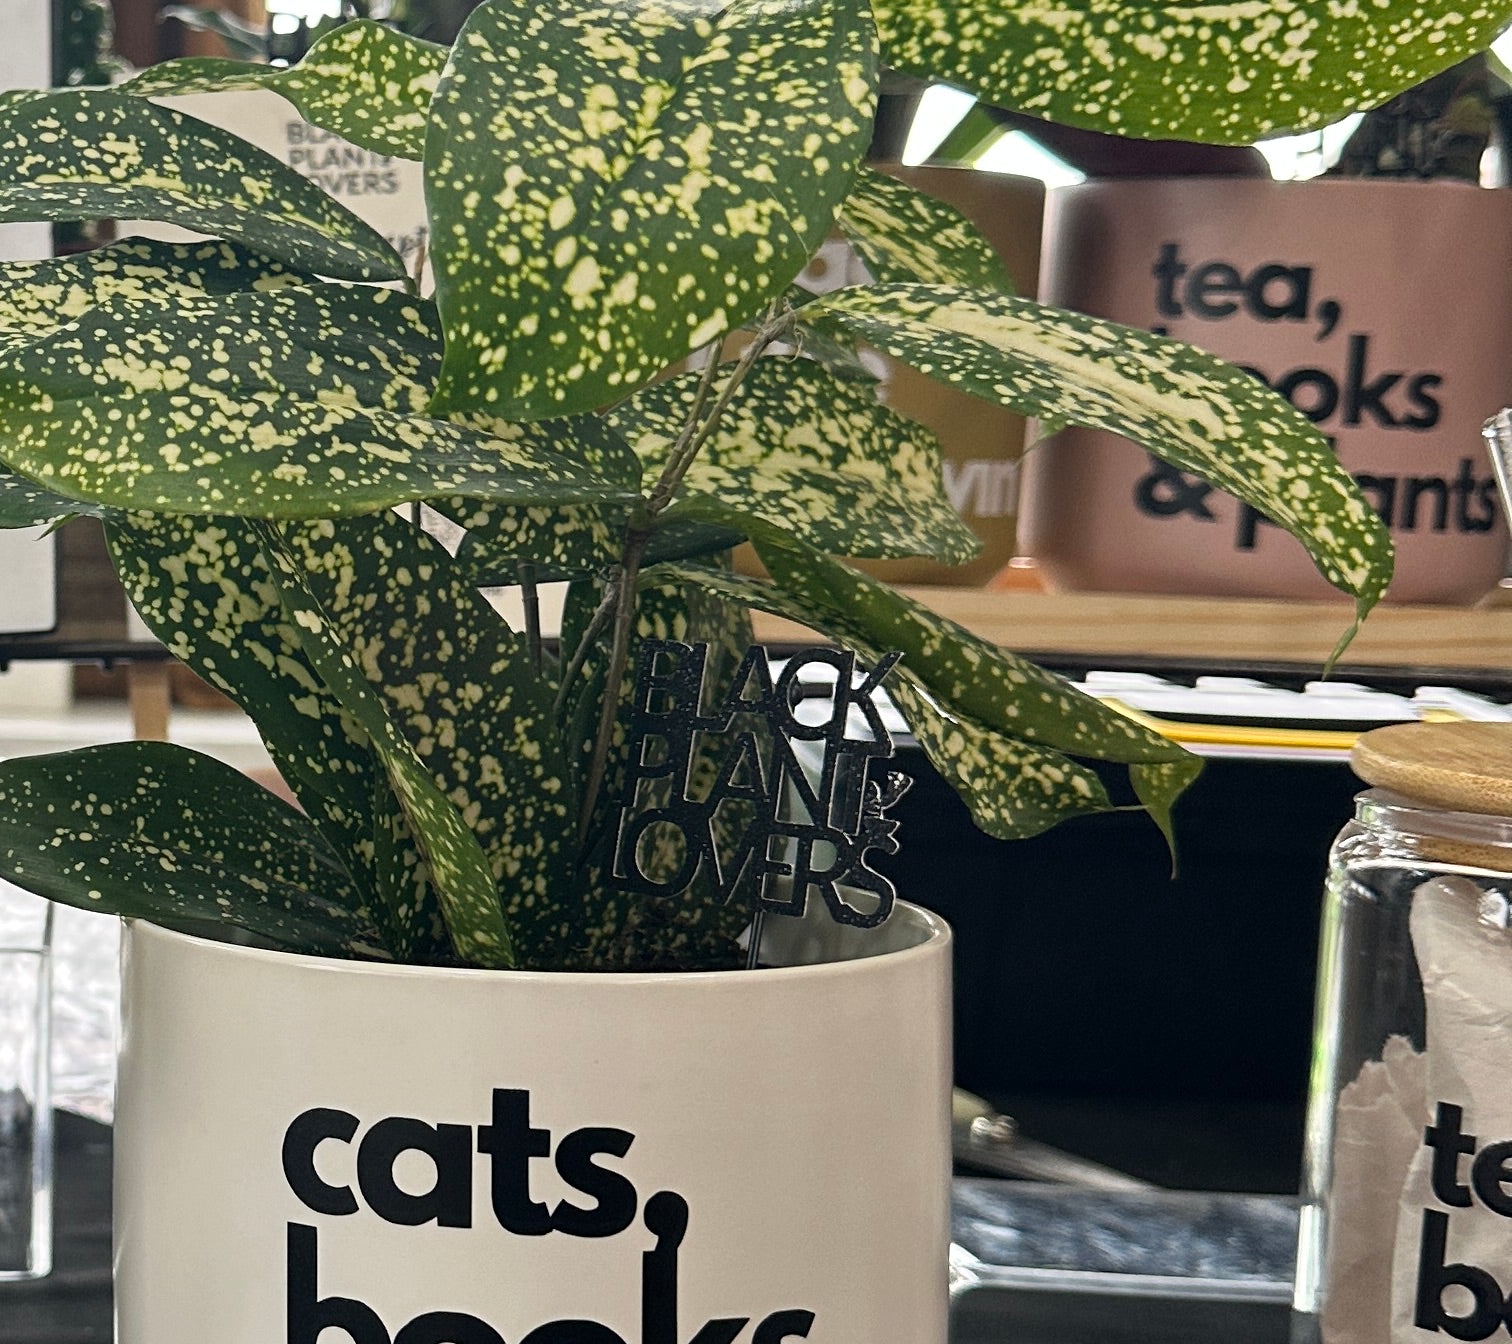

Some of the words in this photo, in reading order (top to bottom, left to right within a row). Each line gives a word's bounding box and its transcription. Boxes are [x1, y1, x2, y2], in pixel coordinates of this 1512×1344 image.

[308, 170, 399, 196] OVERS
[1153, 243, 1342, 342] tea,
[632, 640, 905, 757] BLACK
[612, 806, 897, 929] LOVERS
[282, 1088, 690, 1256] cats,
